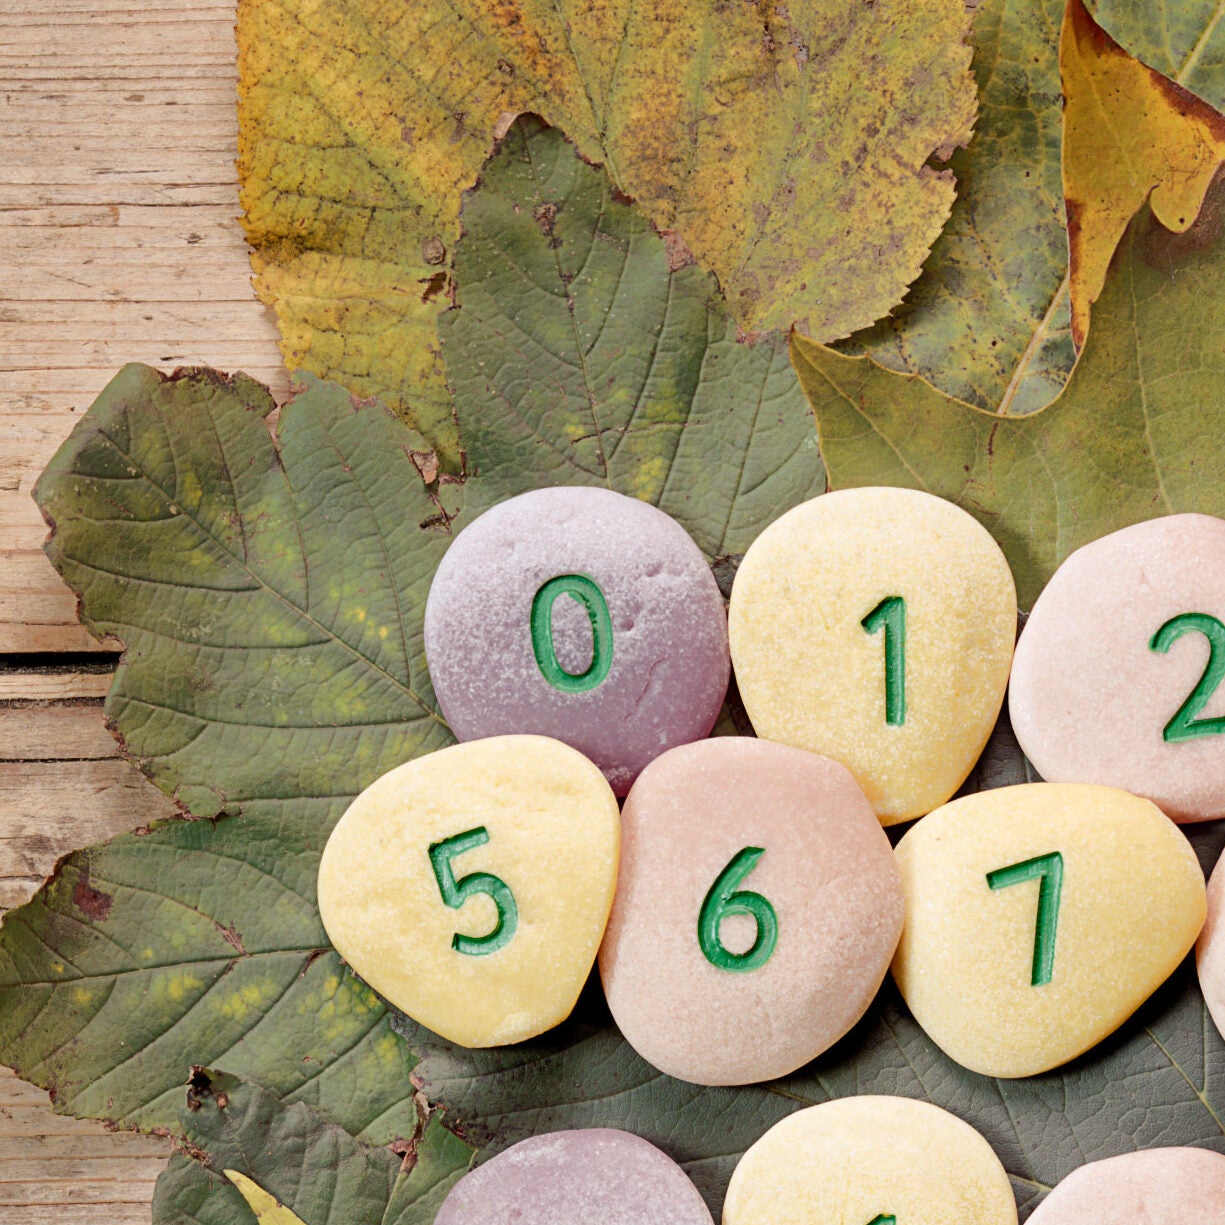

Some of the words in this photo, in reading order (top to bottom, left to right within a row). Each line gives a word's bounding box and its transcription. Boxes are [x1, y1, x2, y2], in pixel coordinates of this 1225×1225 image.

[530, 574, 613, 693] 0
[861, 597, 907, 725] 1
[429, 827, 517, 954] 5
[698, 847, 778, 972] 6
[986, 852, 1063, 986] 7
